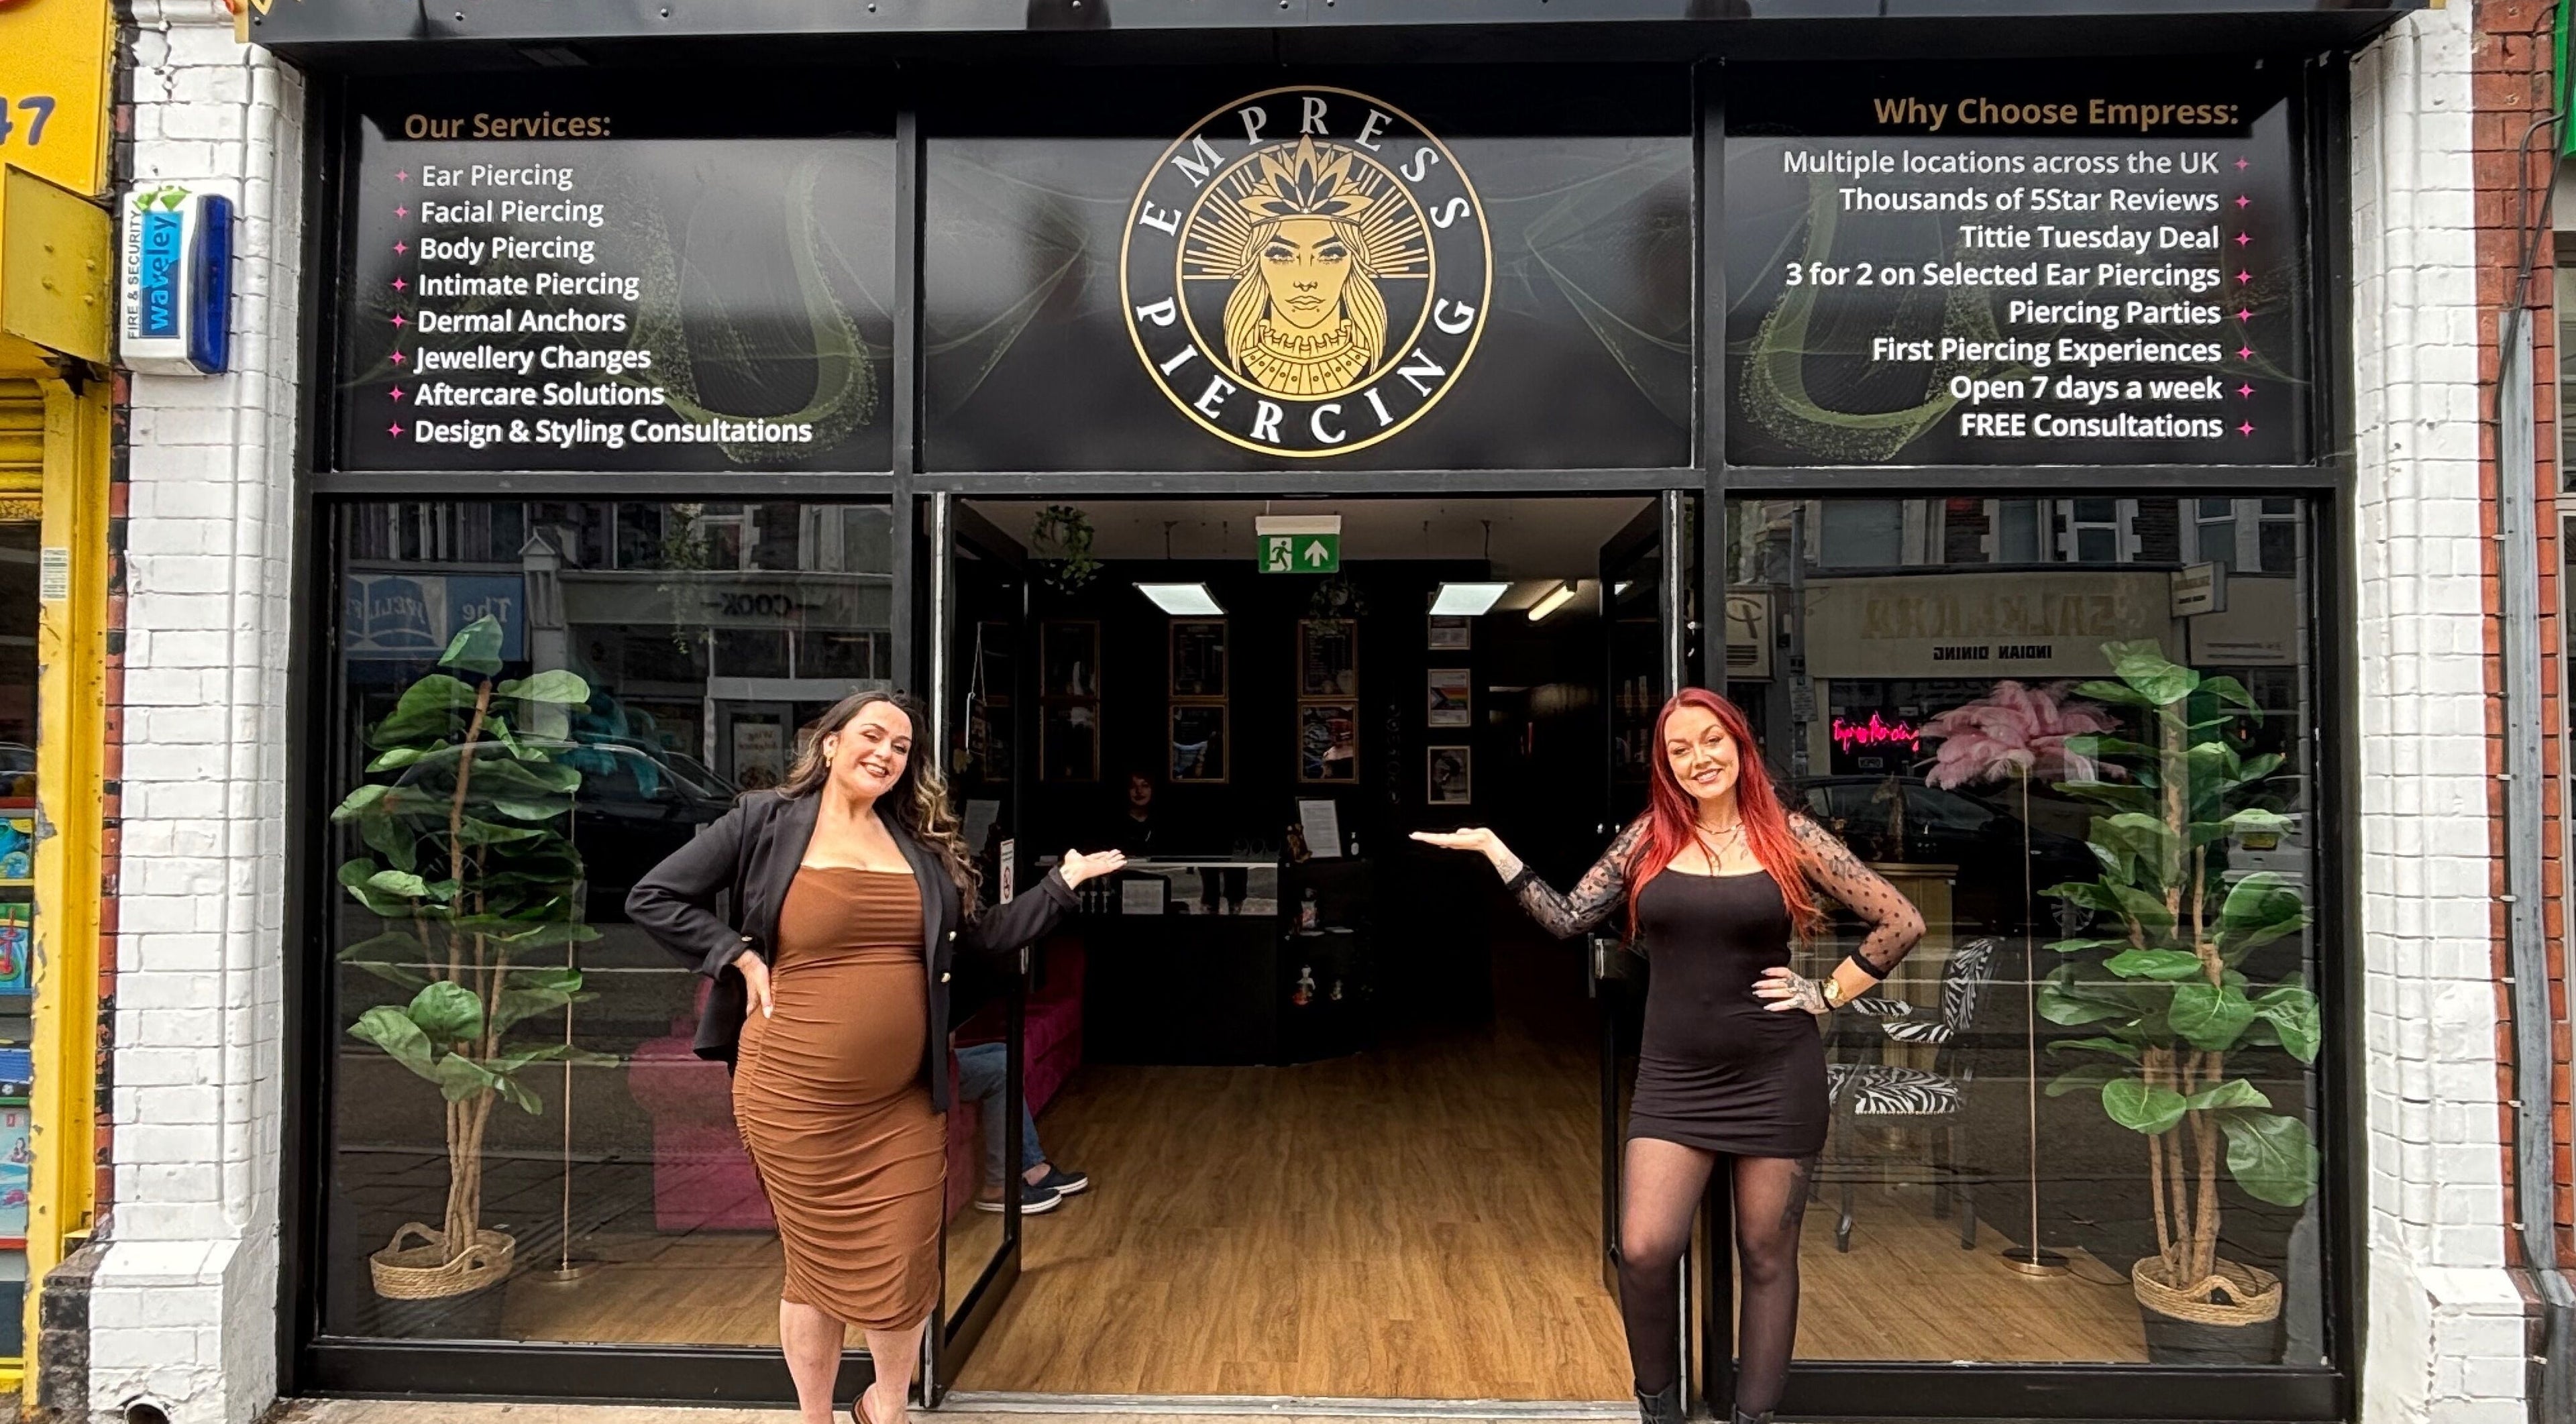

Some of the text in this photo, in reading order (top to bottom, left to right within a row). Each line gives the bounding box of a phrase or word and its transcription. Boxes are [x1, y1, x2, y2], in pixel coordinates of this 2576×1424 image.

[405, 111, 610, 138] Our Services:
[1874, 97, 2239, 131] Why Choose Empress:
[423, 164, 574, 192] Ear Piercing
[1140, 97, 1470, 236] EMPRESS
[1784, 150, 2219, 179] Multiple locations across the UK
[422, 199, 604, 227] Facial Piercing
[1839, 186, 2219, 211] Thousands of 5Star Reviews
[421, 235, 595, 266] Body Piercing
[1960, 225, 2218, 254] Tittie Tuesday Deal
[127, 210, 142, 339] FIRE & SECURITY
[146, 216, 177, 330] waveley
[419, 272, 640, 301] Intimate Piercing
[1786, 262, 2220, 292] 3 for 2 on Selected Ear Piercings
[418, 308, 626, 333] Dermal Anchors
[2010, 300, 2222, 329] Piercing Parties
[413, 345, 651, 375] Jewellery Changes
[1872, 336, 2222, 368] First Piercing Experiences
[1136, 296, 1476, 443] PIERCING
[414, 382, 665, 406] Aftercare Solutions
[1950, 374, 2223, 405] Open 7 days a week
[415, 418, 812, 449] Design & Styling Consultations
[1961, 413, 2223, 437] FREE Consultations
